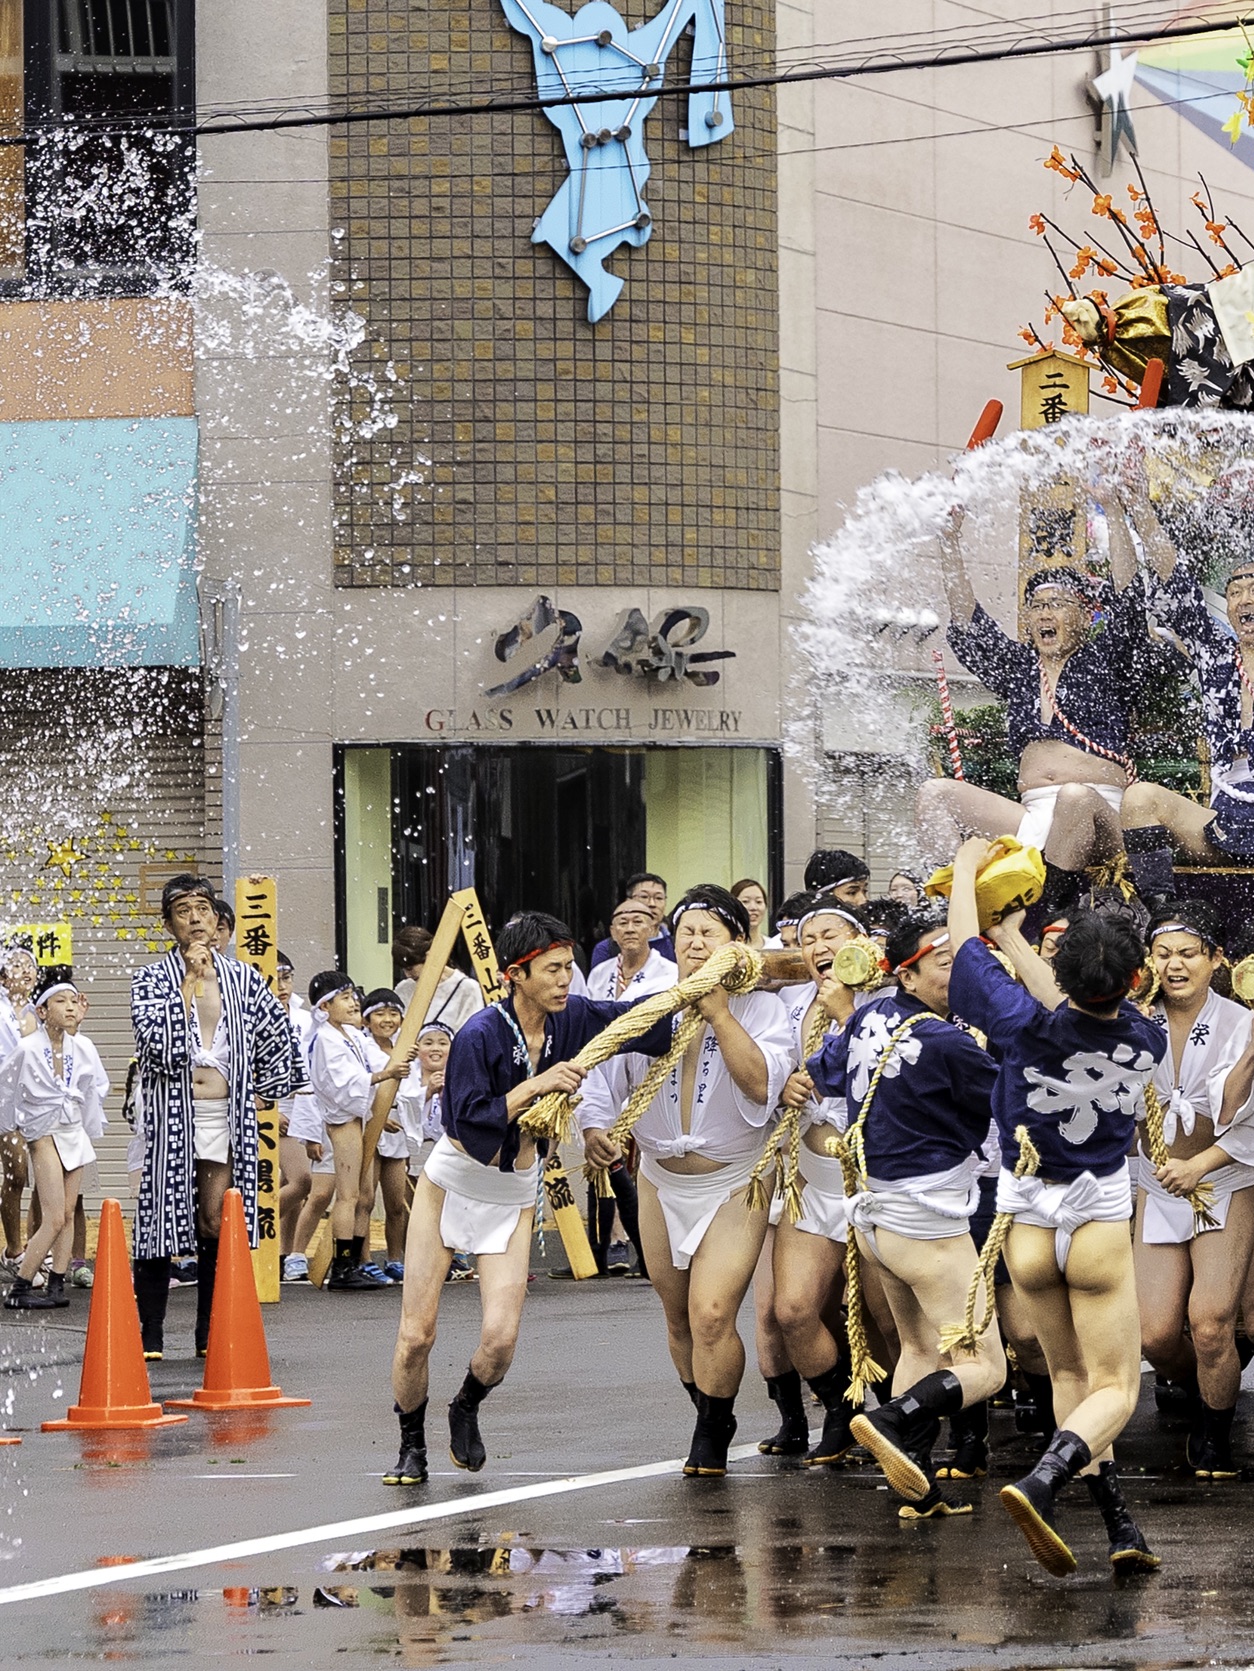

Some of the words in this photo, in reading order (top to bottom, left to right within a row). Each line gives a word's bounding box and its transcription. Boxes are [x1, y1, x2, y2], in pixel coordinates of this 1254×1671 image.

[425, 708, 513, 731] GLASS
[535, 708, 631, 731] WATCH
[649, 708, 743, 732] JEWELRY
[1190, 1022, 1210, 1046] 栄
